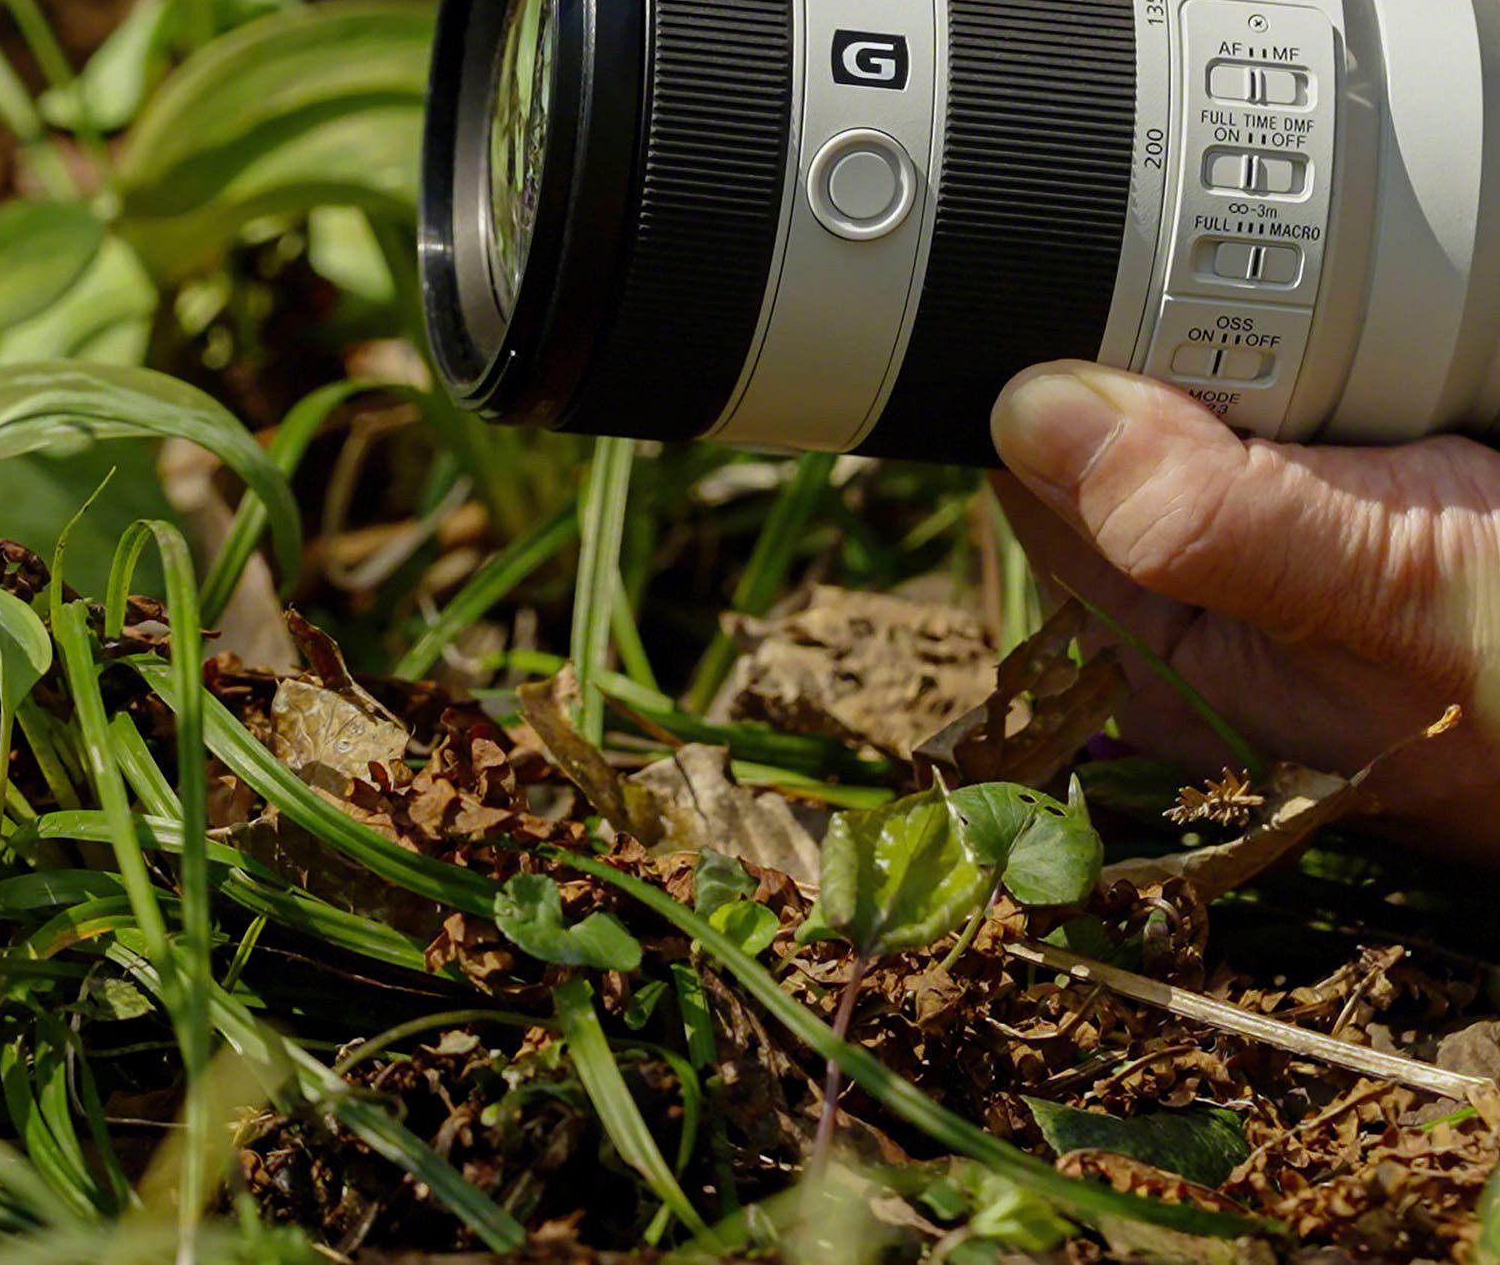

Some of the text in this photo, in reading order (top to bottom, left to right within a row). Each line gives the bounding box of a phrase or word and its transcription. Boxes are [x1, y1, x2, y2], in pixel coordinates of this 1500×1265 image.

[842, 41, 896, 81] G
[1218, 41, 1300, 61] AF MF
[1201, 109, 1315, 133] FULL TIME DMF
[1214, 127, 1307, 148] ON OFF
[1144, 128, 1164, 170] 200
[1194, 215, 1321, 241] FULL MACRO
[1216, 316, 1254, 332] OSS
[1188, 328, 1281, 348] ON OFF
